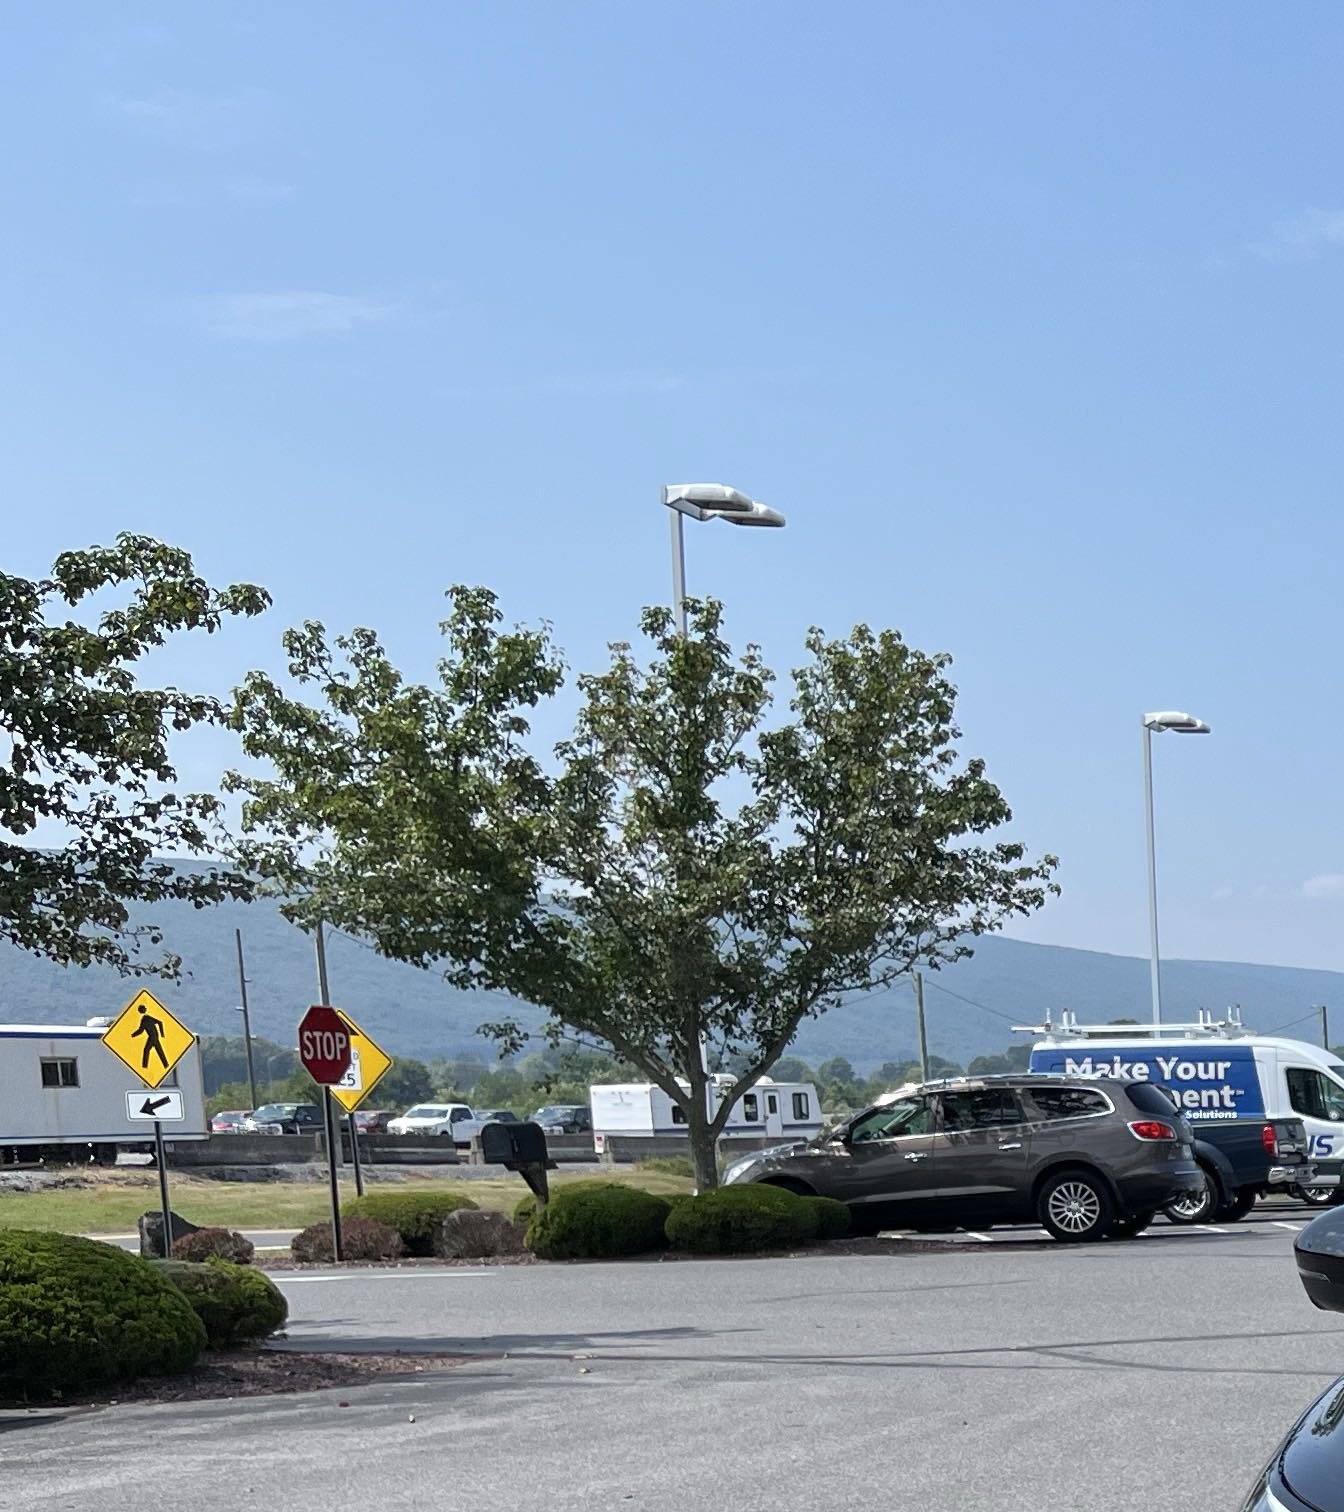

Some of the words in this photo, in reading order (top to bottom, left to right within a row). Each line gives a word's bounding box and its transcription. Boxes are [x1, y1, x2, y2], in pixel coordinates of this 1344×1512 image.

[303, 1030, 347, 1060] STOP
[1065, 1056, 1150, 1081] Make
[1156, 1057, 1231, 1081] Your
[1185, 1109, 1238, 1119] Solutions
